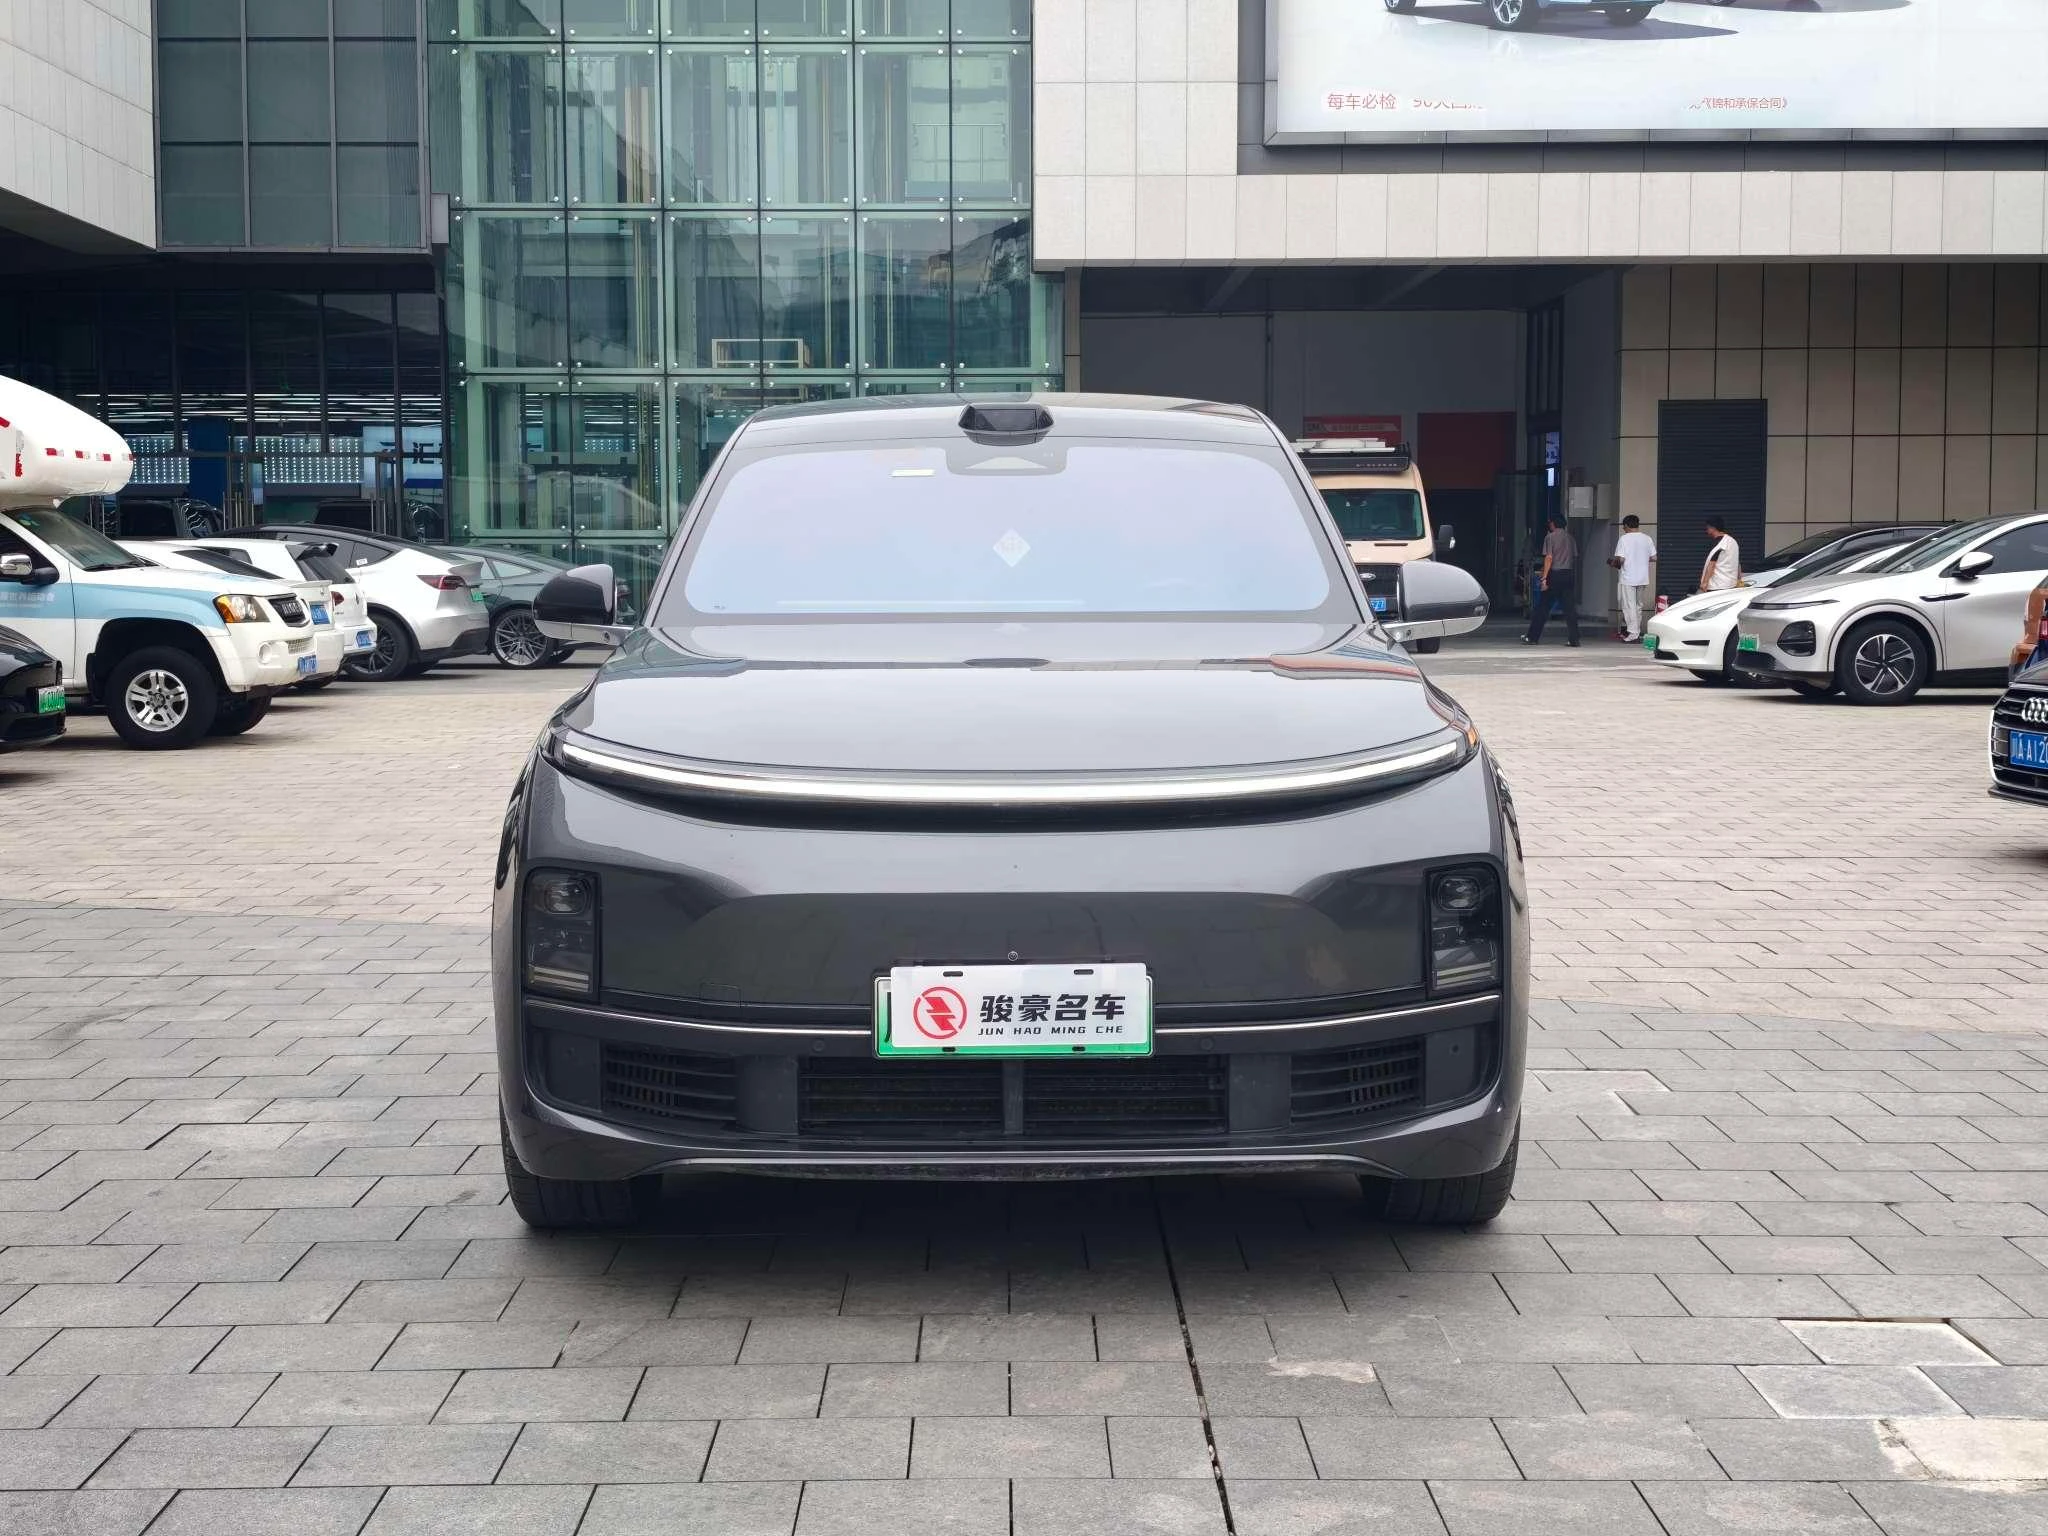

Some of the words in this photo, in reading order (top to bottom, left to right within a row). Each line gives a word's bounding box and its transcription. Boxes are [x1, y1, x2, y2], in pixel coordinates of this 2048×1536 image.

[1327, 93, 1397, 110] 每车必检
[979, 993, 1126, 1024] 骏豪名车
[977, 1027, 1005, 1036] JUN
[1013, 1026, 1042, 1035] HAO
[1050, 1026, 1087, 1035] MING
[1095, 1025, 1124, 1034] CHE
